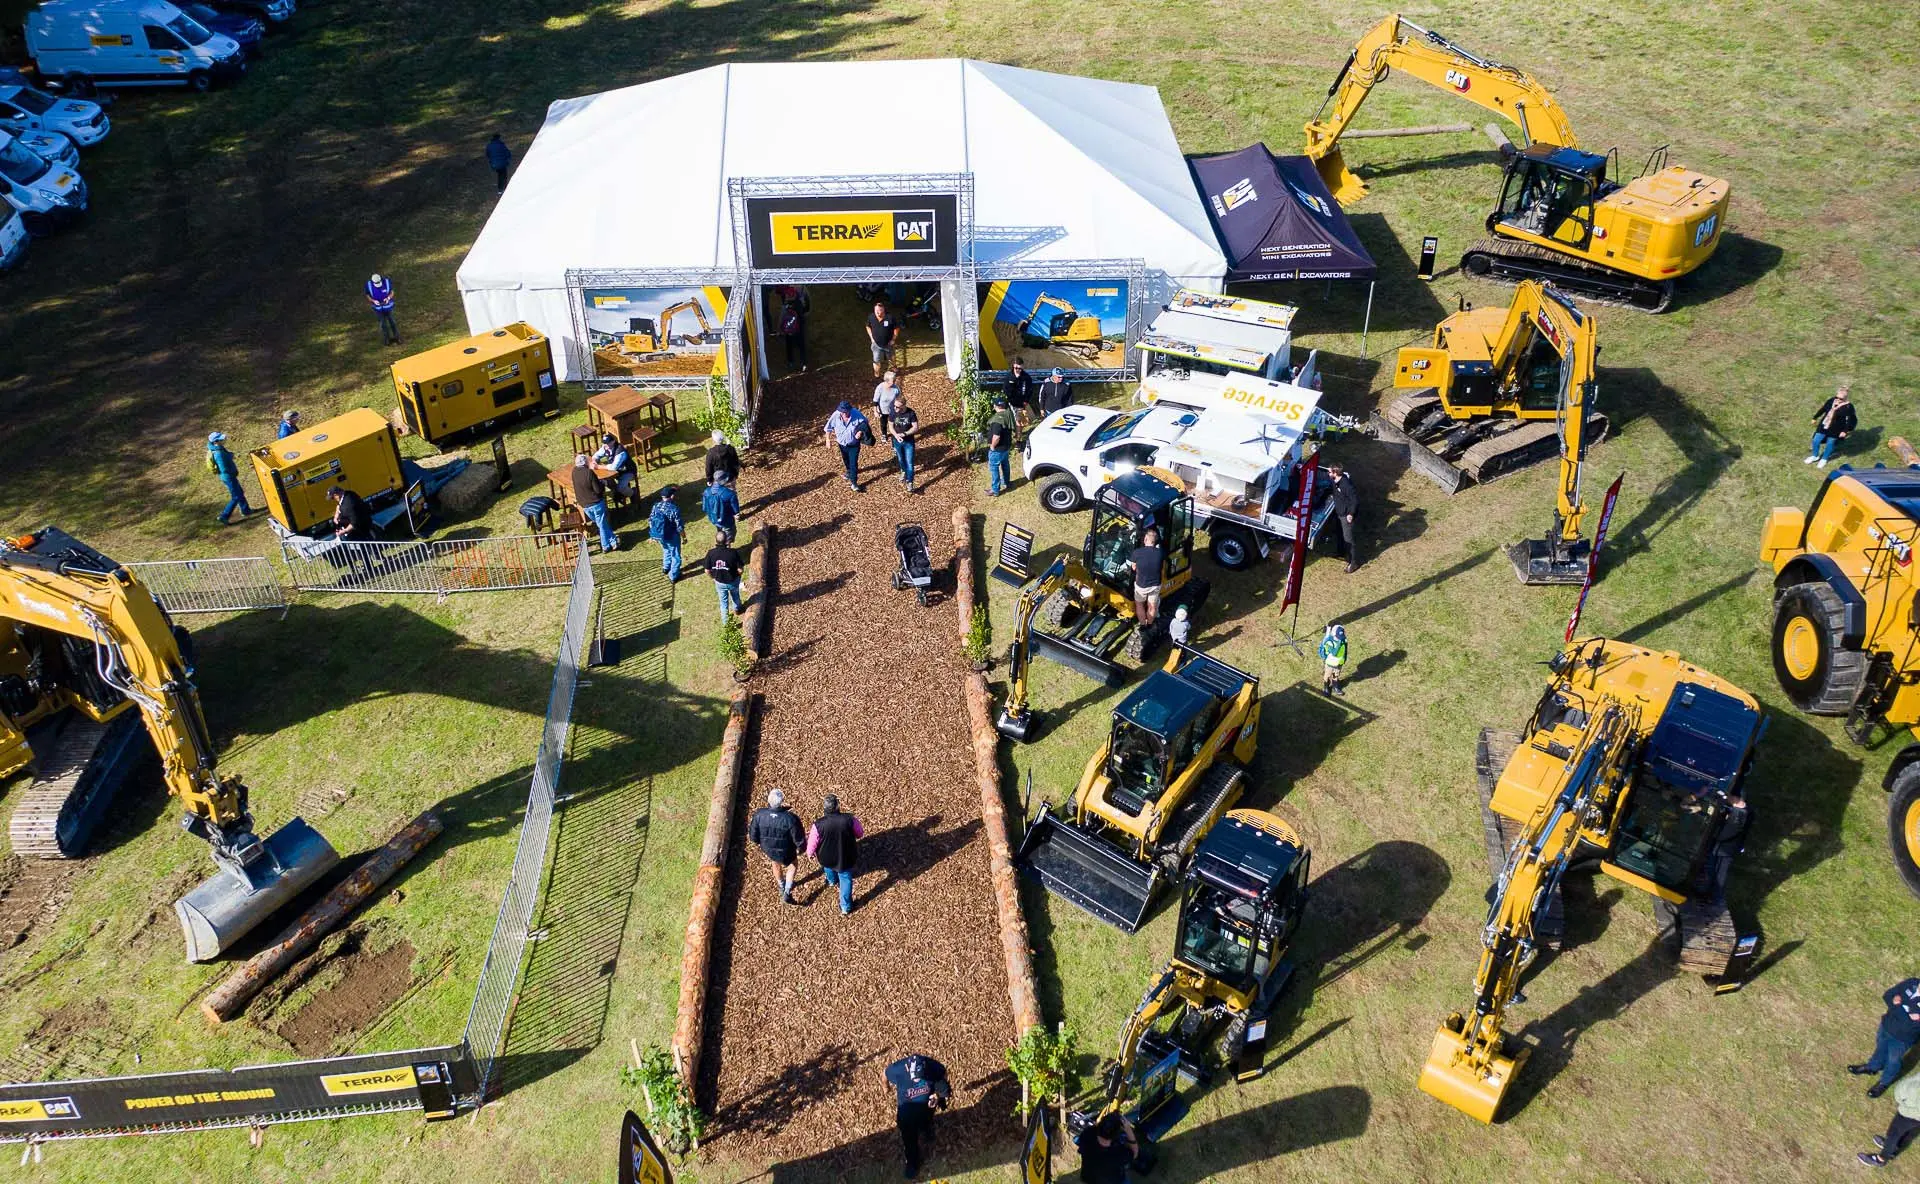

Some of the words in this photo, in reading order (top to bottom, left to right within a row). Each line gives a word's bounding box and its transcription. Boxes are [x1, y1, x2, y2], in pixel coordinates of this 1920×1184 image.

[1446, 70, 1467, 89] CAT
[1222, 178, 1258, 211] CAT
[792, 224, 863, 241] TERRA
[897, 221, 932, 241] CAT
[1592, 226, 1605, 237] AT
[1694, 215, 1716, 246] CAT
[1282, 243, 1331, 251] GENERATION
[1412, 359, 1427, 370] CAT
[1223, 385, 1304, 421] Service
[1050, 413, 1085, 432] CAT
[340, 1074, 395, 1088] TERRA
[44, 1102, 71, 1115] CAT
[124, 1096, 175, 1111] POWER
[174, 1094, 195, 1106] ON
[194, 1092, 222, 1104] THE
[220, 1088, 276, 1101] GROUND
